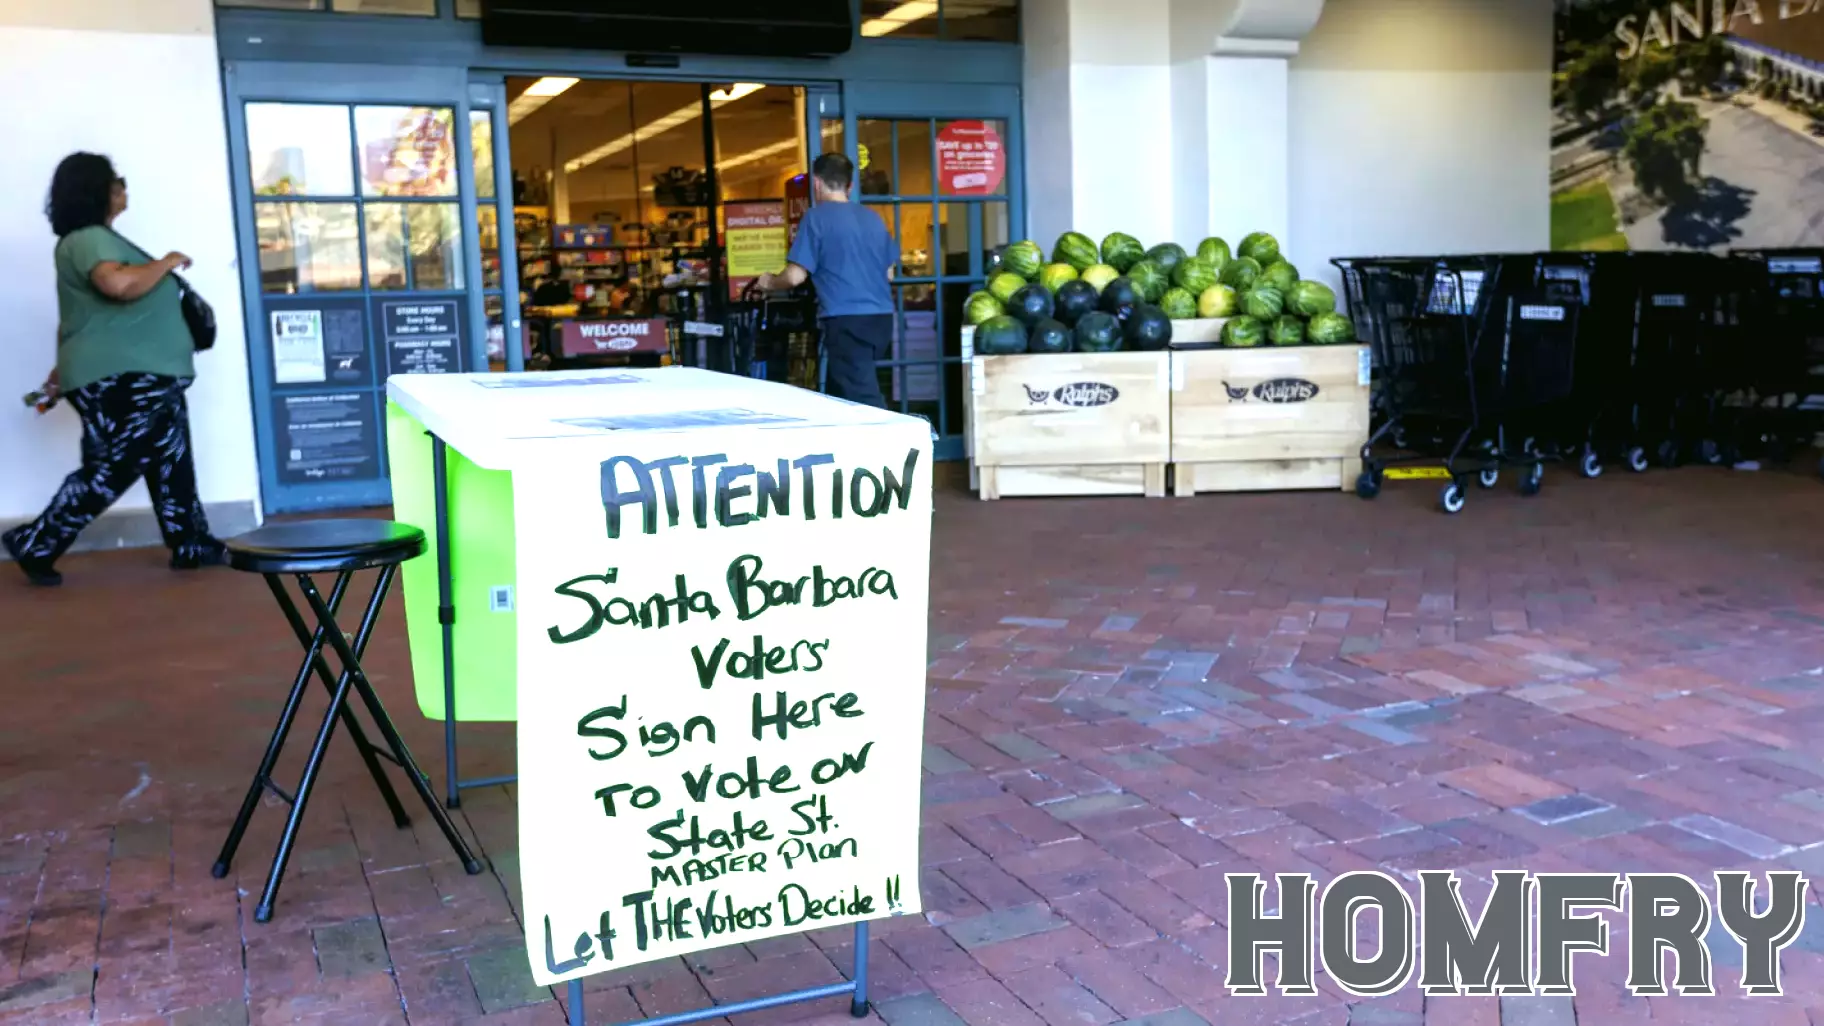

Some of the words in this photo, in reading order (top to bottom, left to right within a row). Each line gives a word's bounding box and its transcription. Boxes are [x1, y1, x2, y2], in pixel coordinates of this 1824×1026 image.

[579, 322, 650, 338] WELCOME
[1059, 383, 1114, 407] Ralphs
[1258, 381, 1314, 404] Ralphs
[600, 448, 919, 539] ATTENTION
[547, 567, 722, 645] Santa
[726, 554, 899, 621] Barbara
[691, 635, 831, 690] Voters
[577, 694, 716, 761] Sign
[751, 690, 865, 742] Here
[647, 808, 775, 860] State
[788, 793, 841, 836] St.
[650, 851, 768, 889] MASTER
[776, 838, 859, 870] Plan
[544, 909, 617, 975] Let
[622, 889, 695, 952] THE
[695, 889, 773, 940] Voters
[777, 882, 876, 927] Decide
